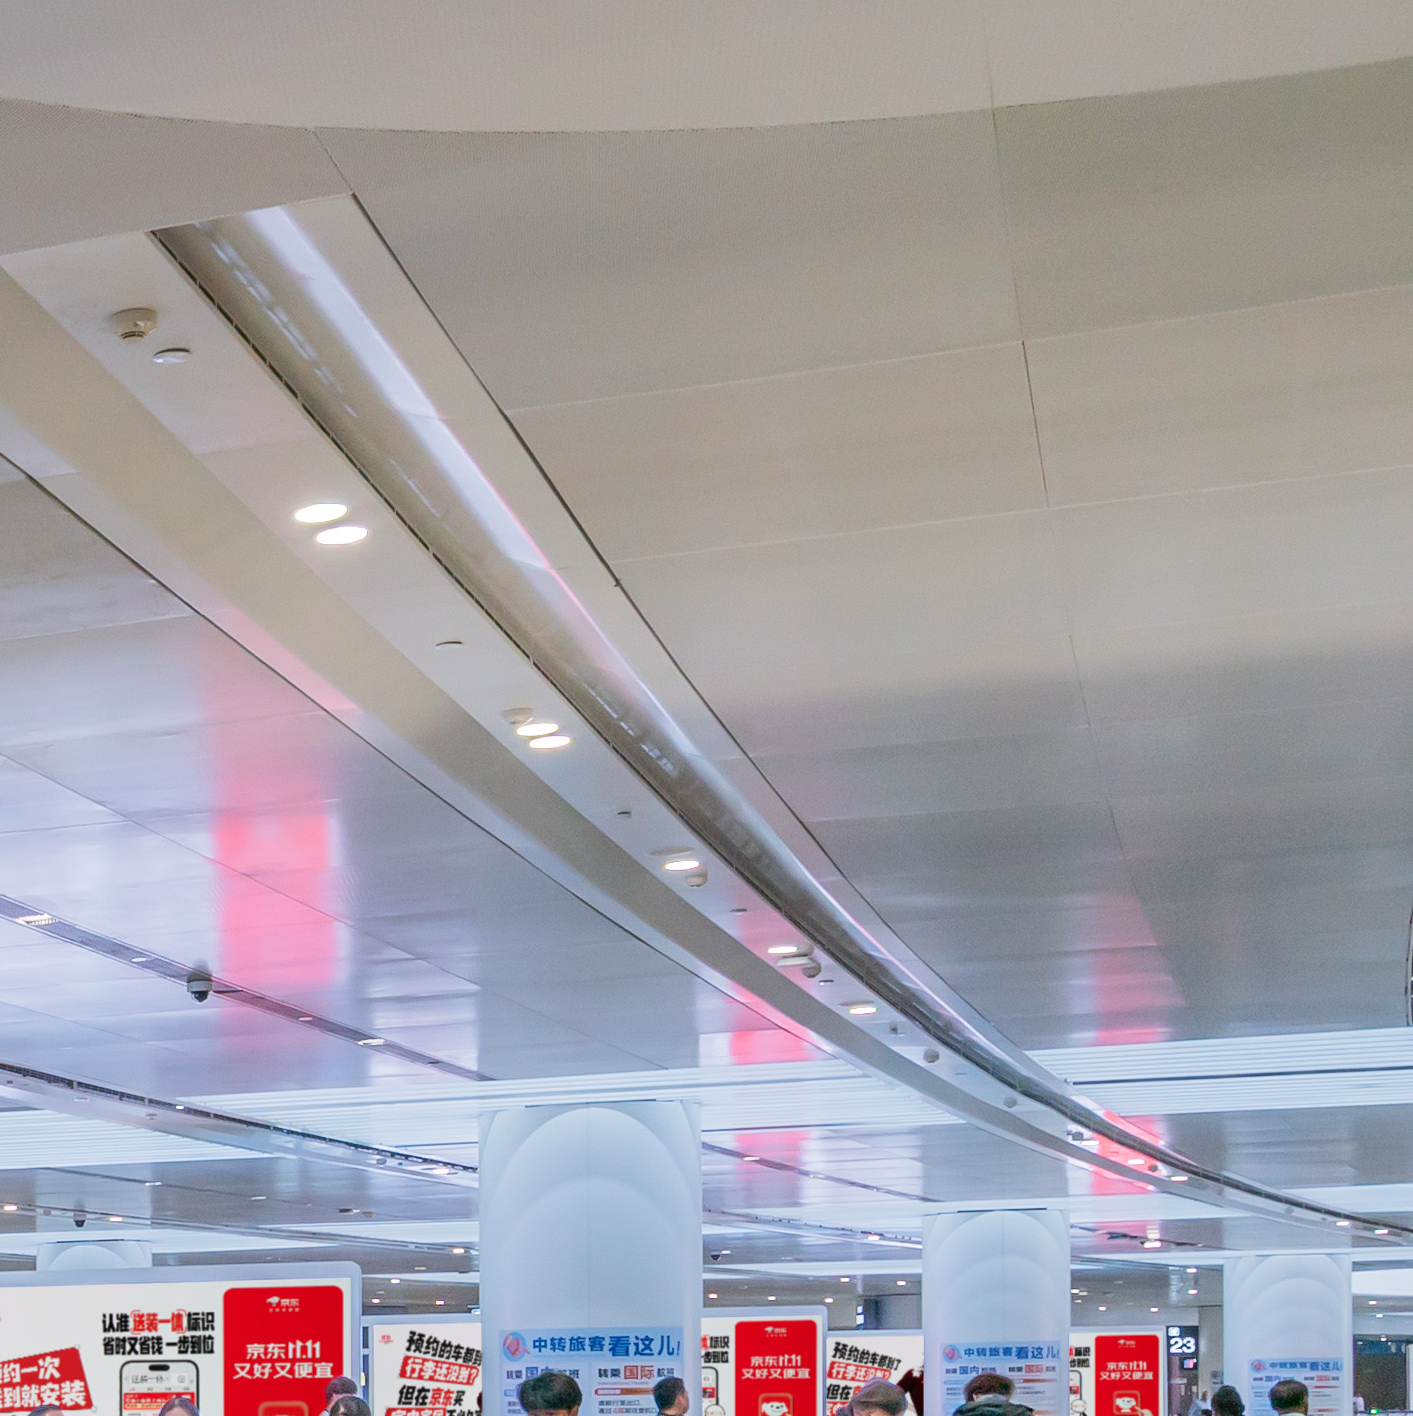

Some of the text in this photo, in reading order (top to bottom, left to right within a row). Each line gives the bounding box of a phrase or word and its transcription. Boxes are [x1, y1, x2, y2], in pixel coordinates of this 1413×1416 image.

[280, 1298, 300, 1307] 京东
[1170, 1336, 1196, 1354] 23
[831, 1341, 901, 1371] 预约的车都到了
[233, 1362, 334, 1379] 又好又便宜
[406, 1358, 478, 1383] 行李还没到?
[741, 1368, 811, 1380] 又好又便宜
[398, 1384, 465, 1406] 但在京东买
